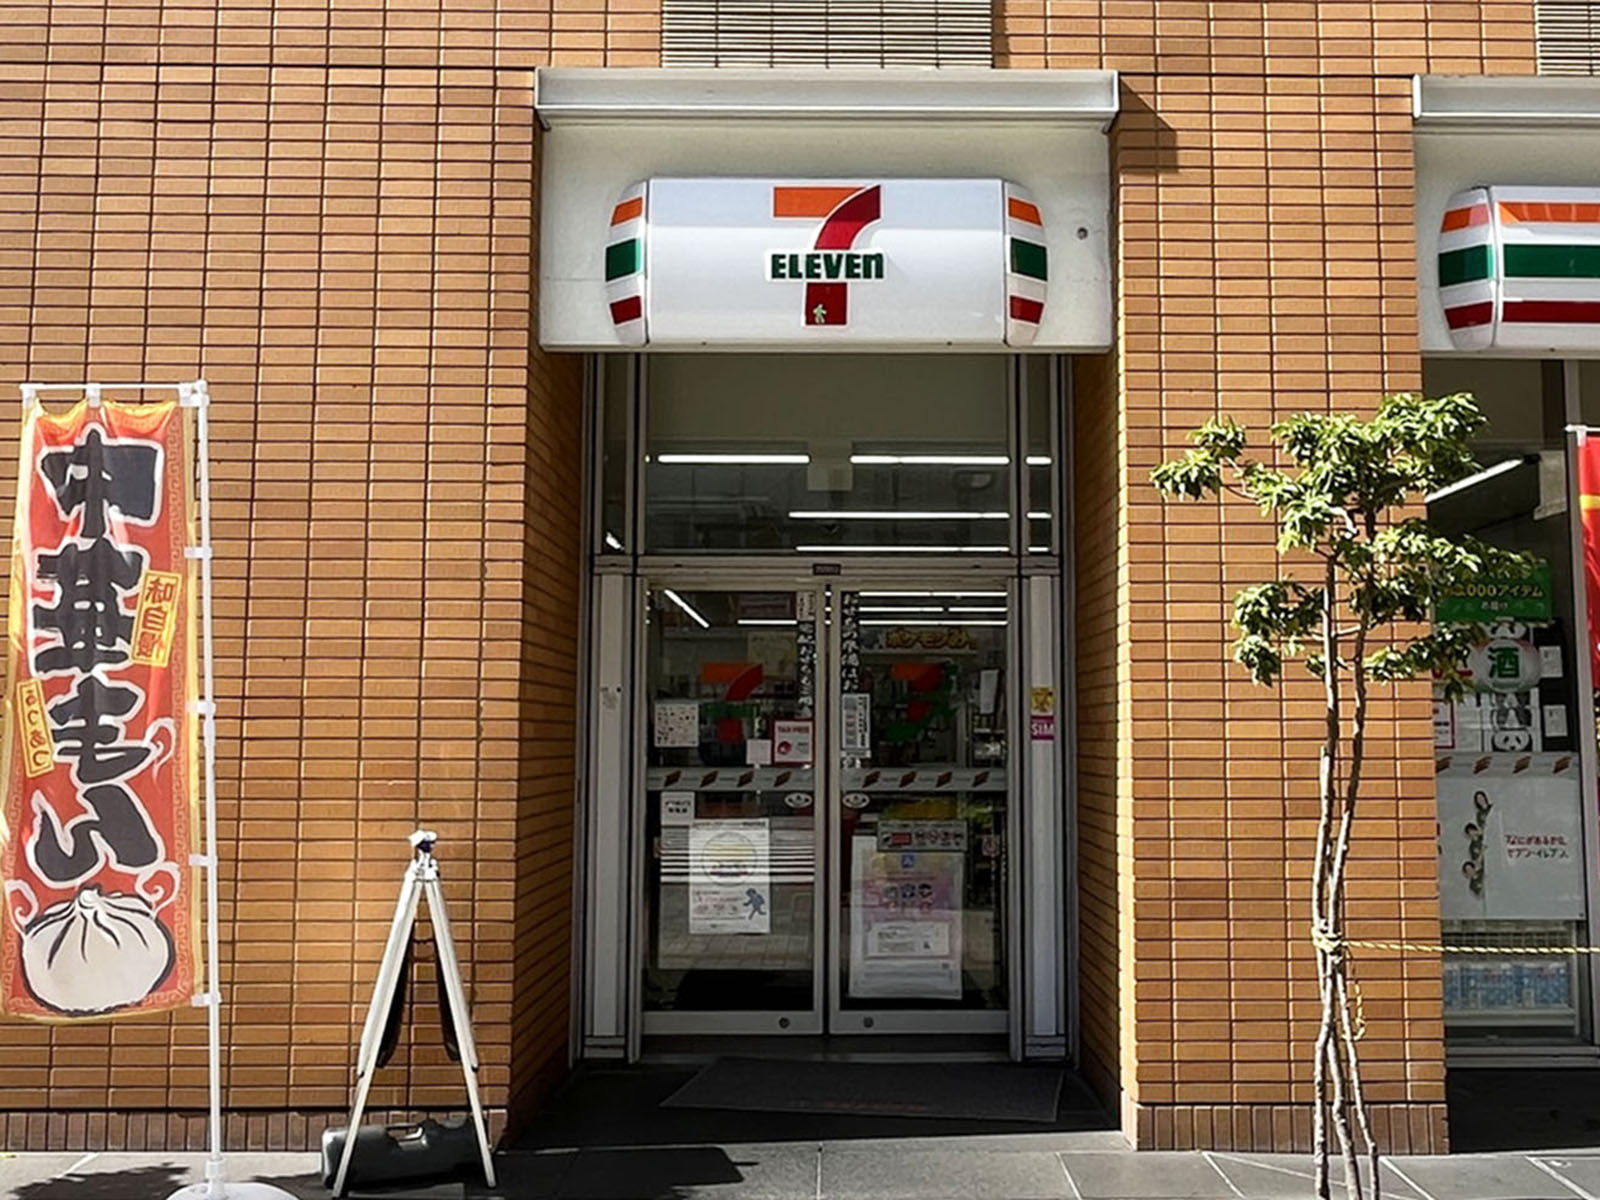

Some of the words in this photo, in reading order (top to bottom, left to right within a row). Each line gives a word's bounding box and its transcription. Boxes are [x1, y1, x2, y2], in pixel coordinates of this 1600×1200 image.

[773, 184, 881, 326] 7
[1488, 646, 1520, 679] 酒
[1032, 723, 1054, 736] SIM
